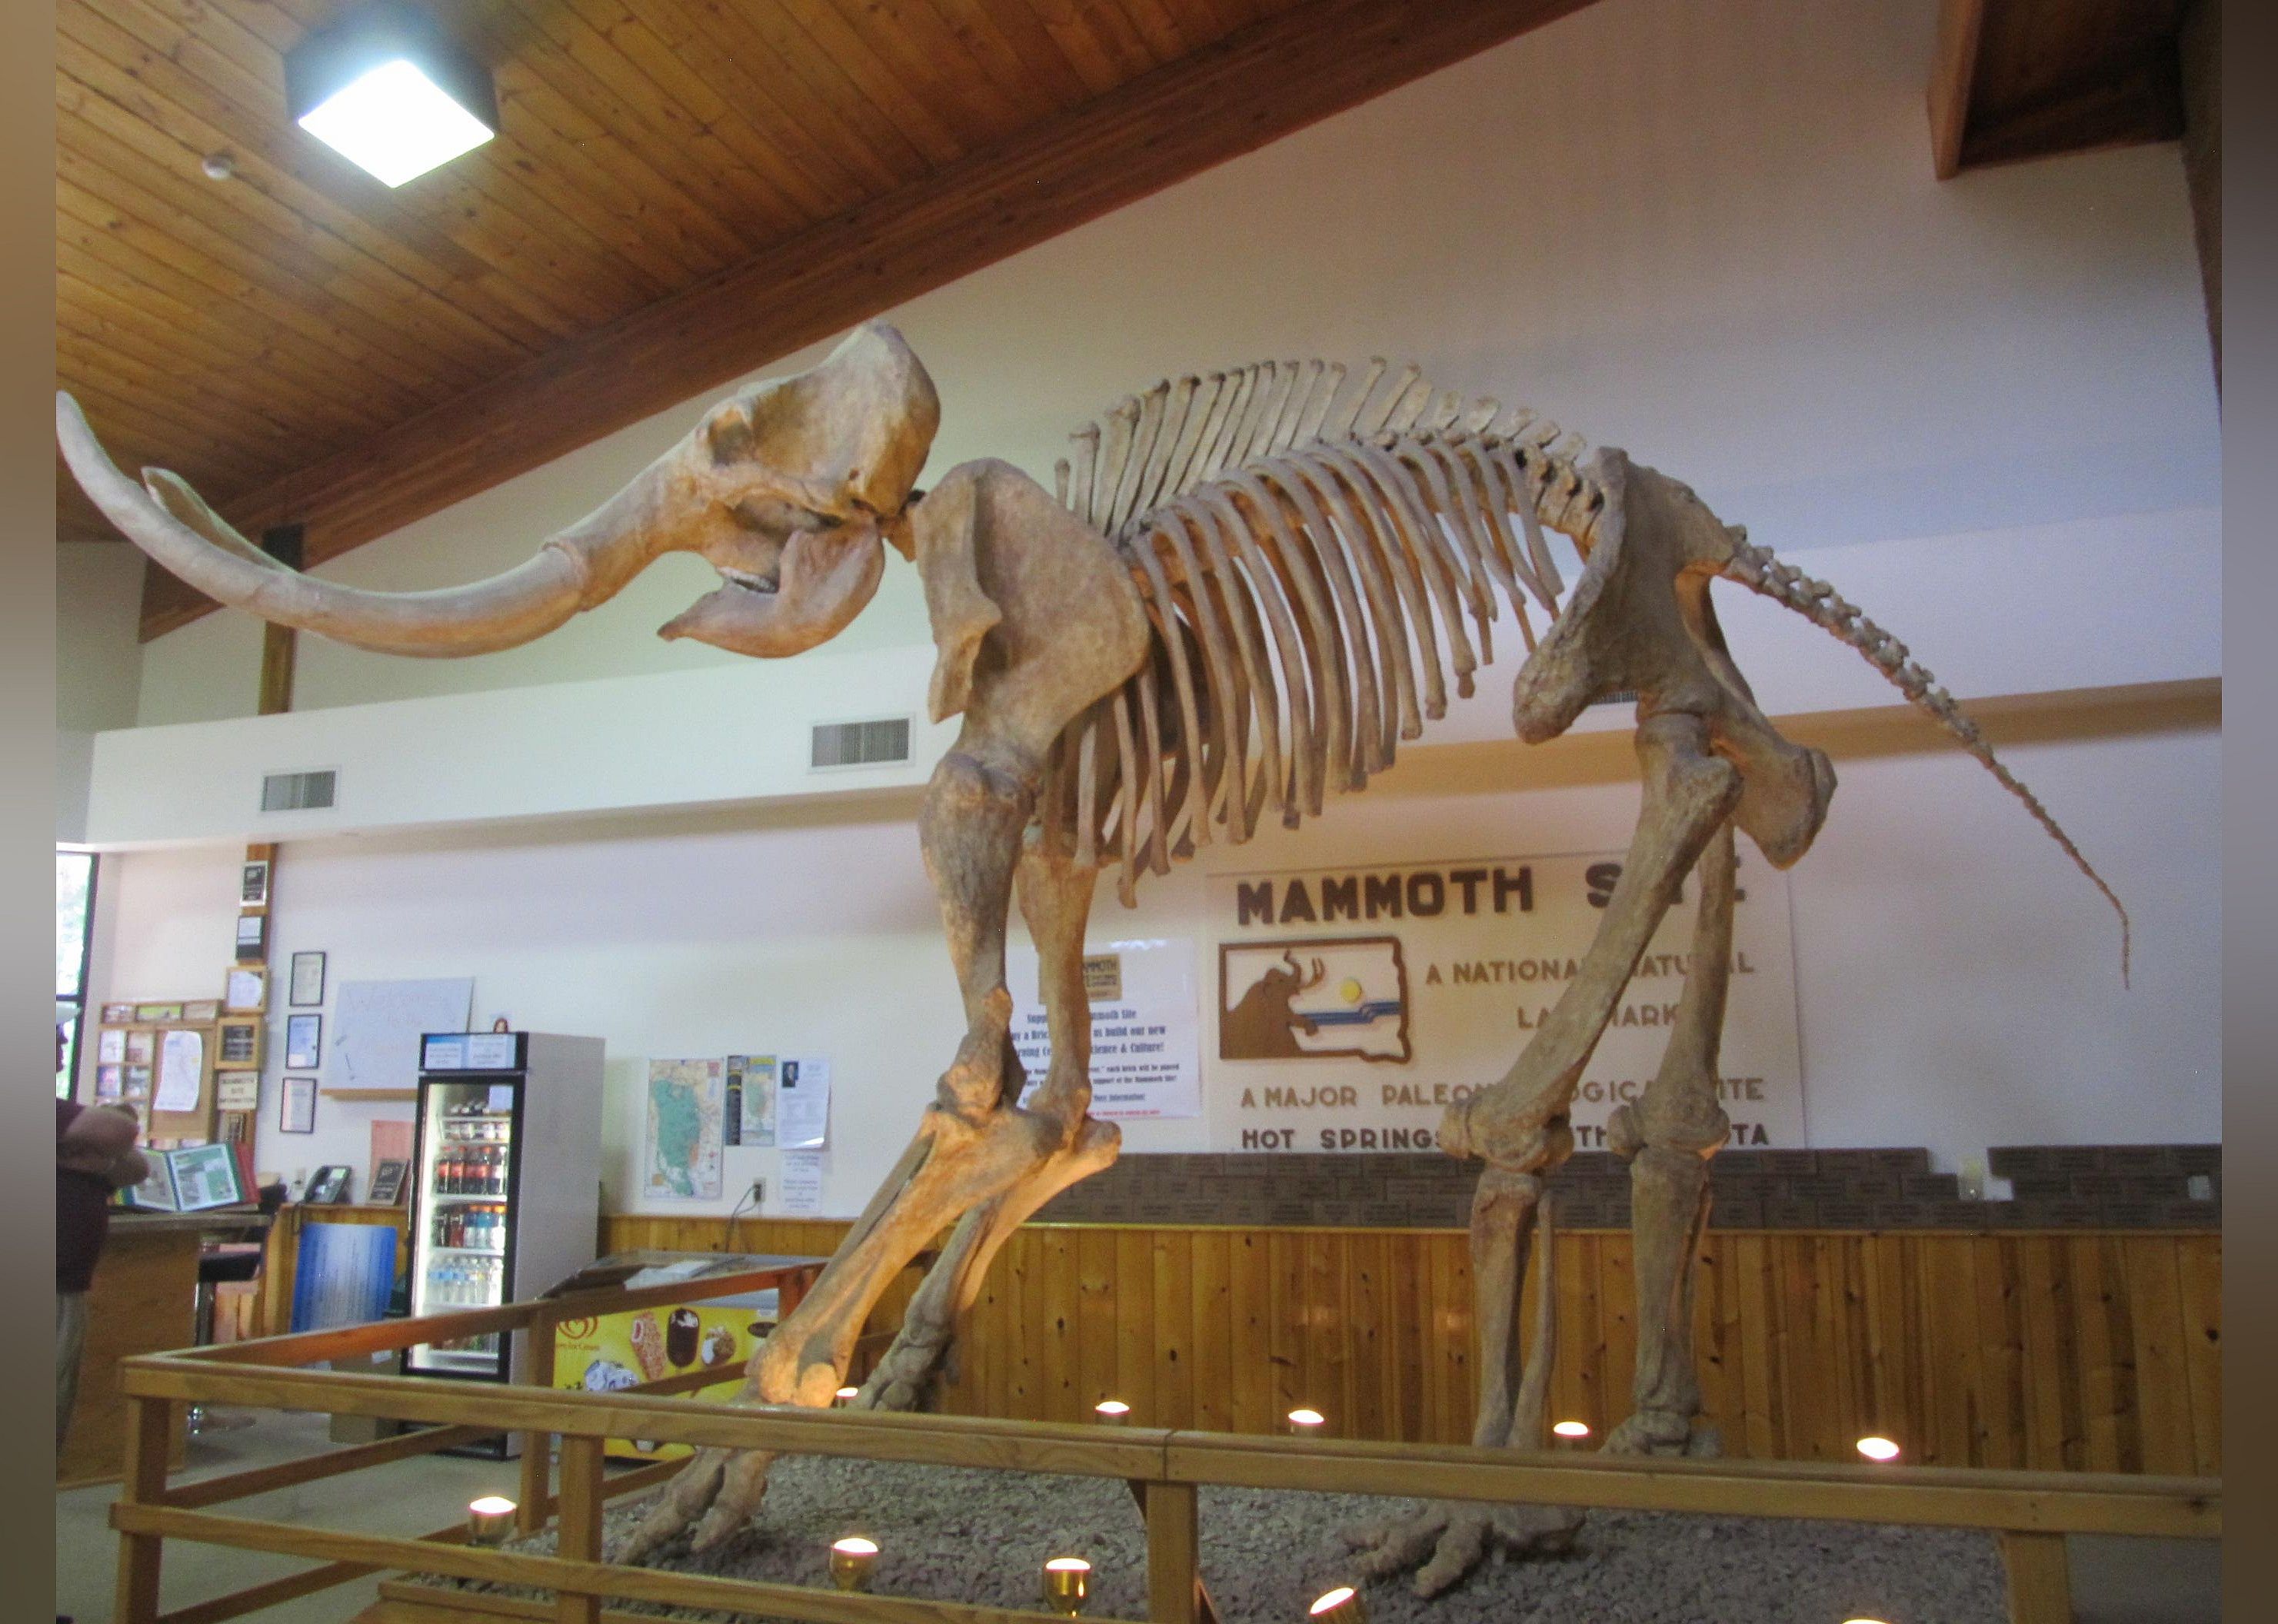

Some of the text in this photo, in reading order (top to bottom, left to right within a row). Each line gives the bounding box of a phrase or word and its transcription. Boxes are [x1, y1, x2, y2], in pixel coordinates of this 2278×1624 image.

[1237, 866, 1534, 927] MAMMOTH
[1426, 963, 1443, 985] A
[1453, 959, 1577, 984] NATIONA
[1122, 1009, 1137, 1020] Site
[1105, 1027, 1127, 1037] build
[1131, 1027, 1144, 1036] our
[1148, 1026, 1166, 1035] new
[1121, 1043, 1127, 1053] &
[1241, 1087, 1255, 1108] A
[1265, 1085, 1357, 1108] MAJOR
[1241, 1128, 1294, 1150] HOT
